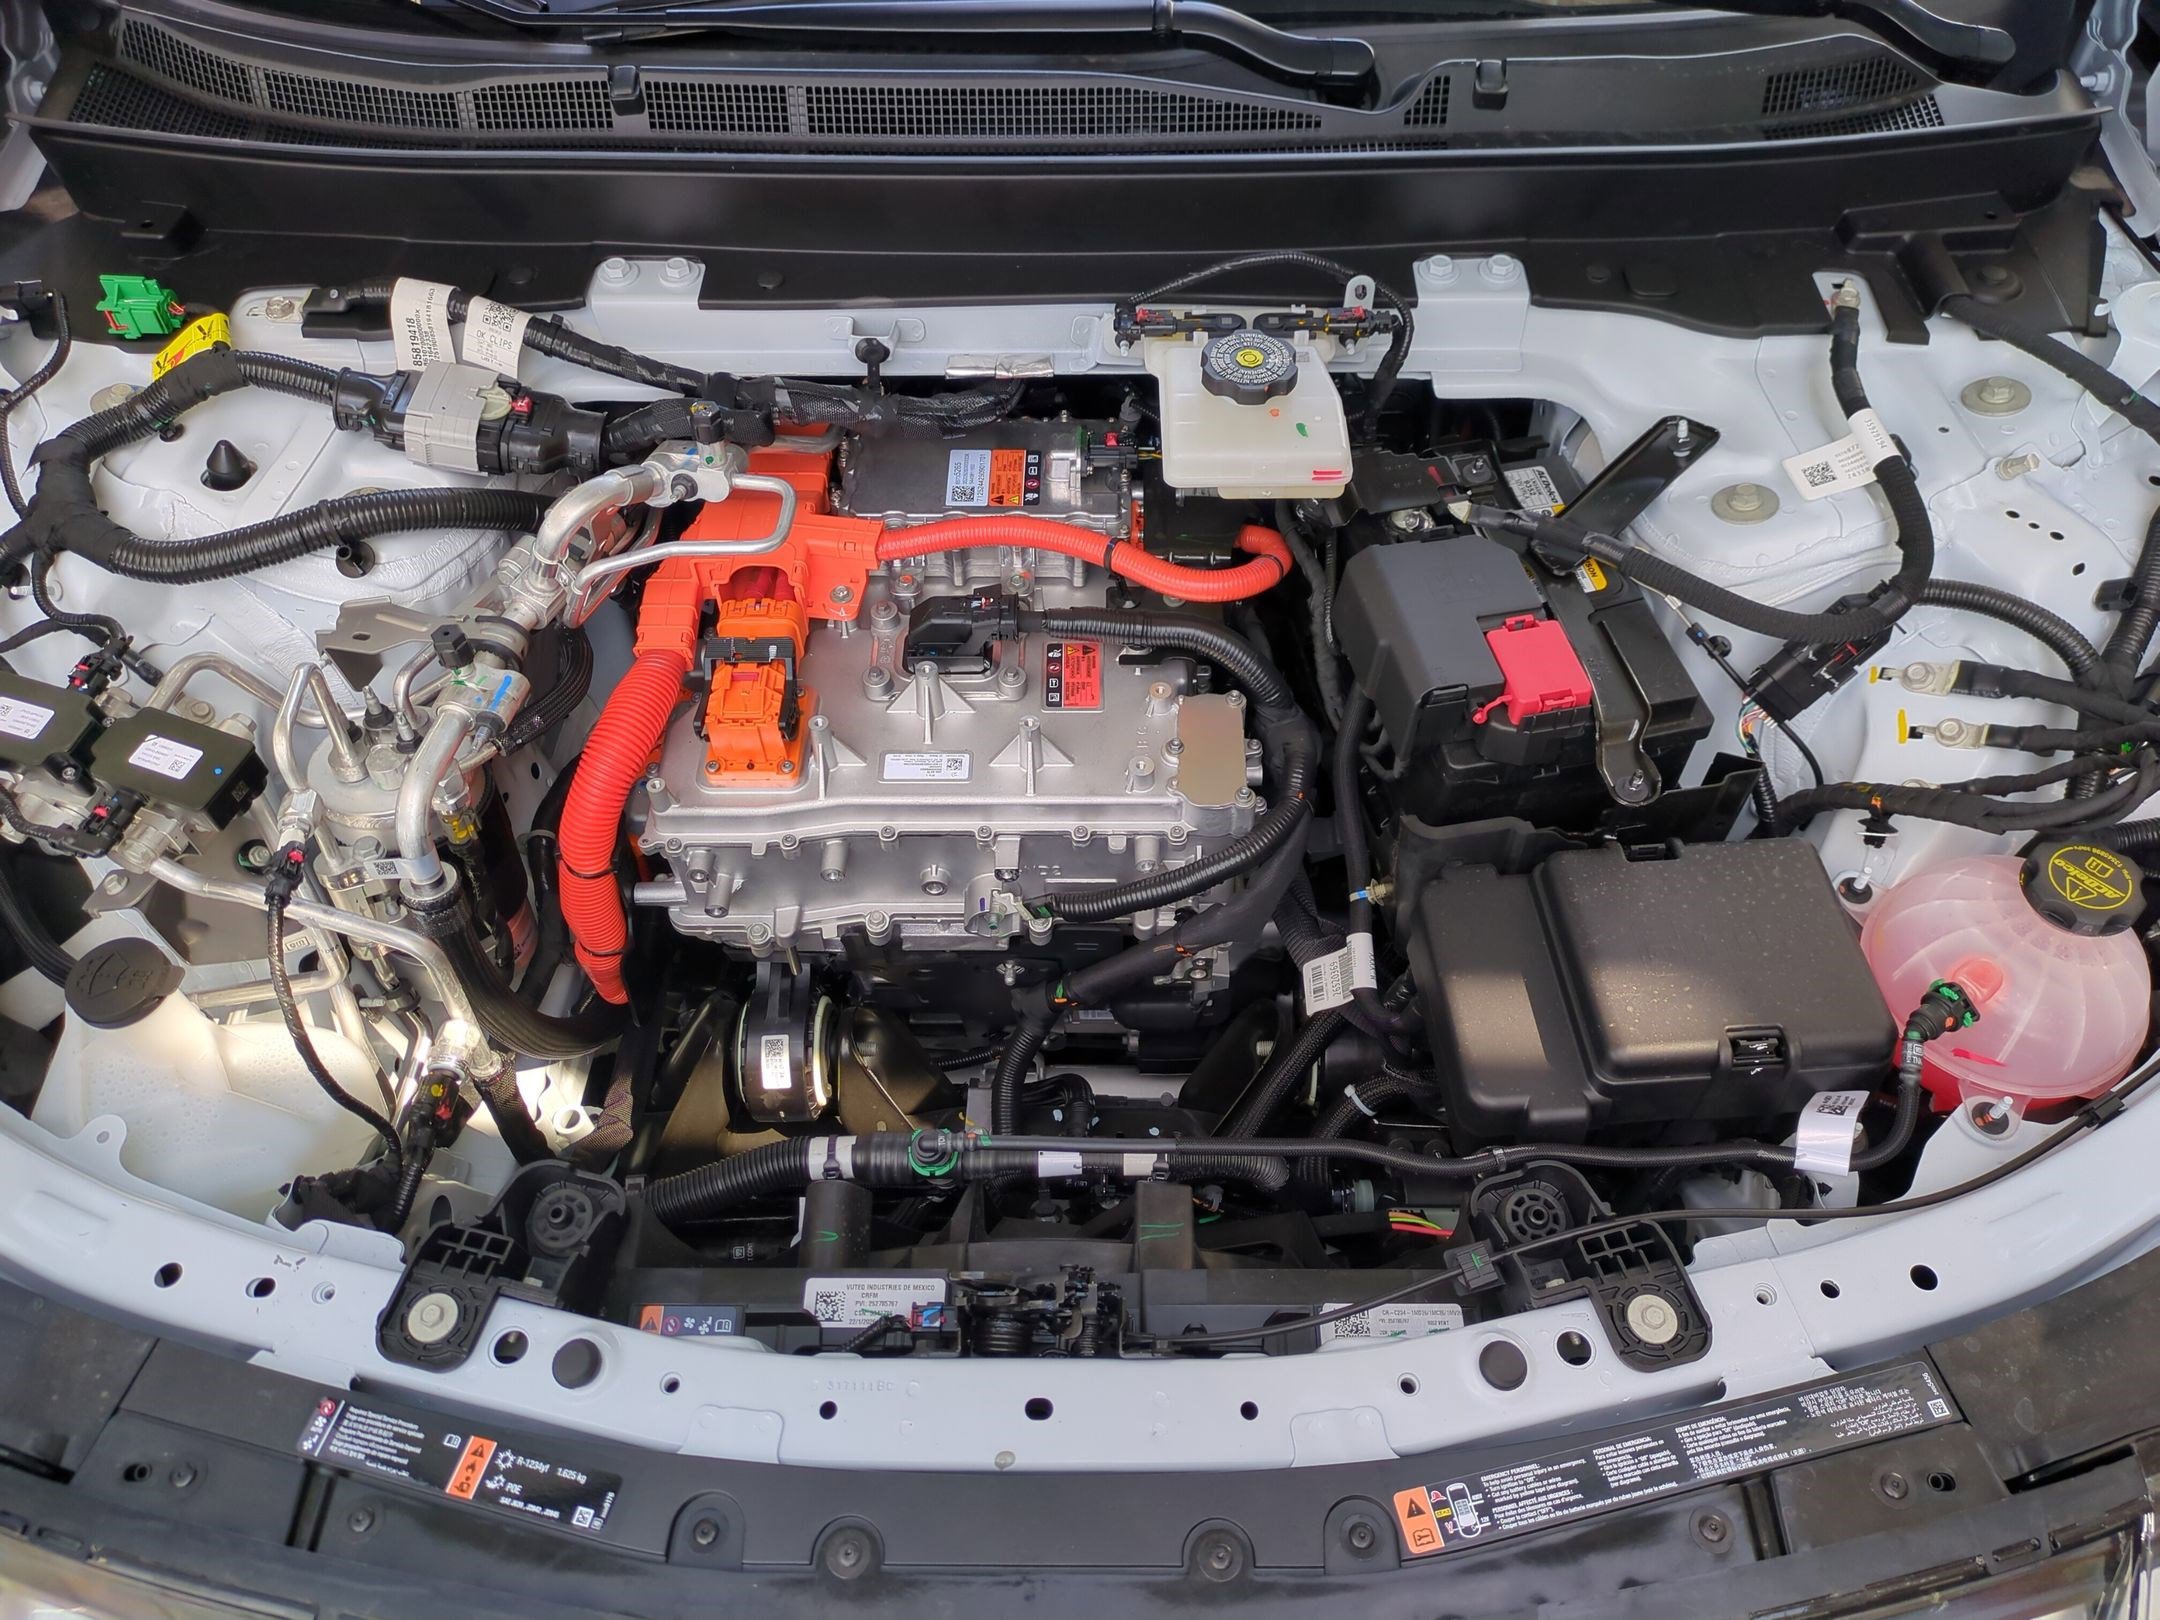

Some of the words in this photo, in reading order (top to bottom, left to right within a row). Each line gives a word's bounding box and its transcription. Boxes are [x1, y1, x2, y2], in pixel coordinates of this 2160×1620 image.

[407, 317, 423, 367] 85819418
[477, 329, 488, 339] OK
[490, 334, 513, 349] CLIPS
[1536, 468, 1560, 504] ACDelco
[2054, 858, 2121, 898] ACDelco
[514, 1455, 550, 1474] R-1234yf
[555, 1467, 577, 1480] 1.625
[575, 1473, 587, 1484] kg
[504, 1482, 522, 1494] POE
